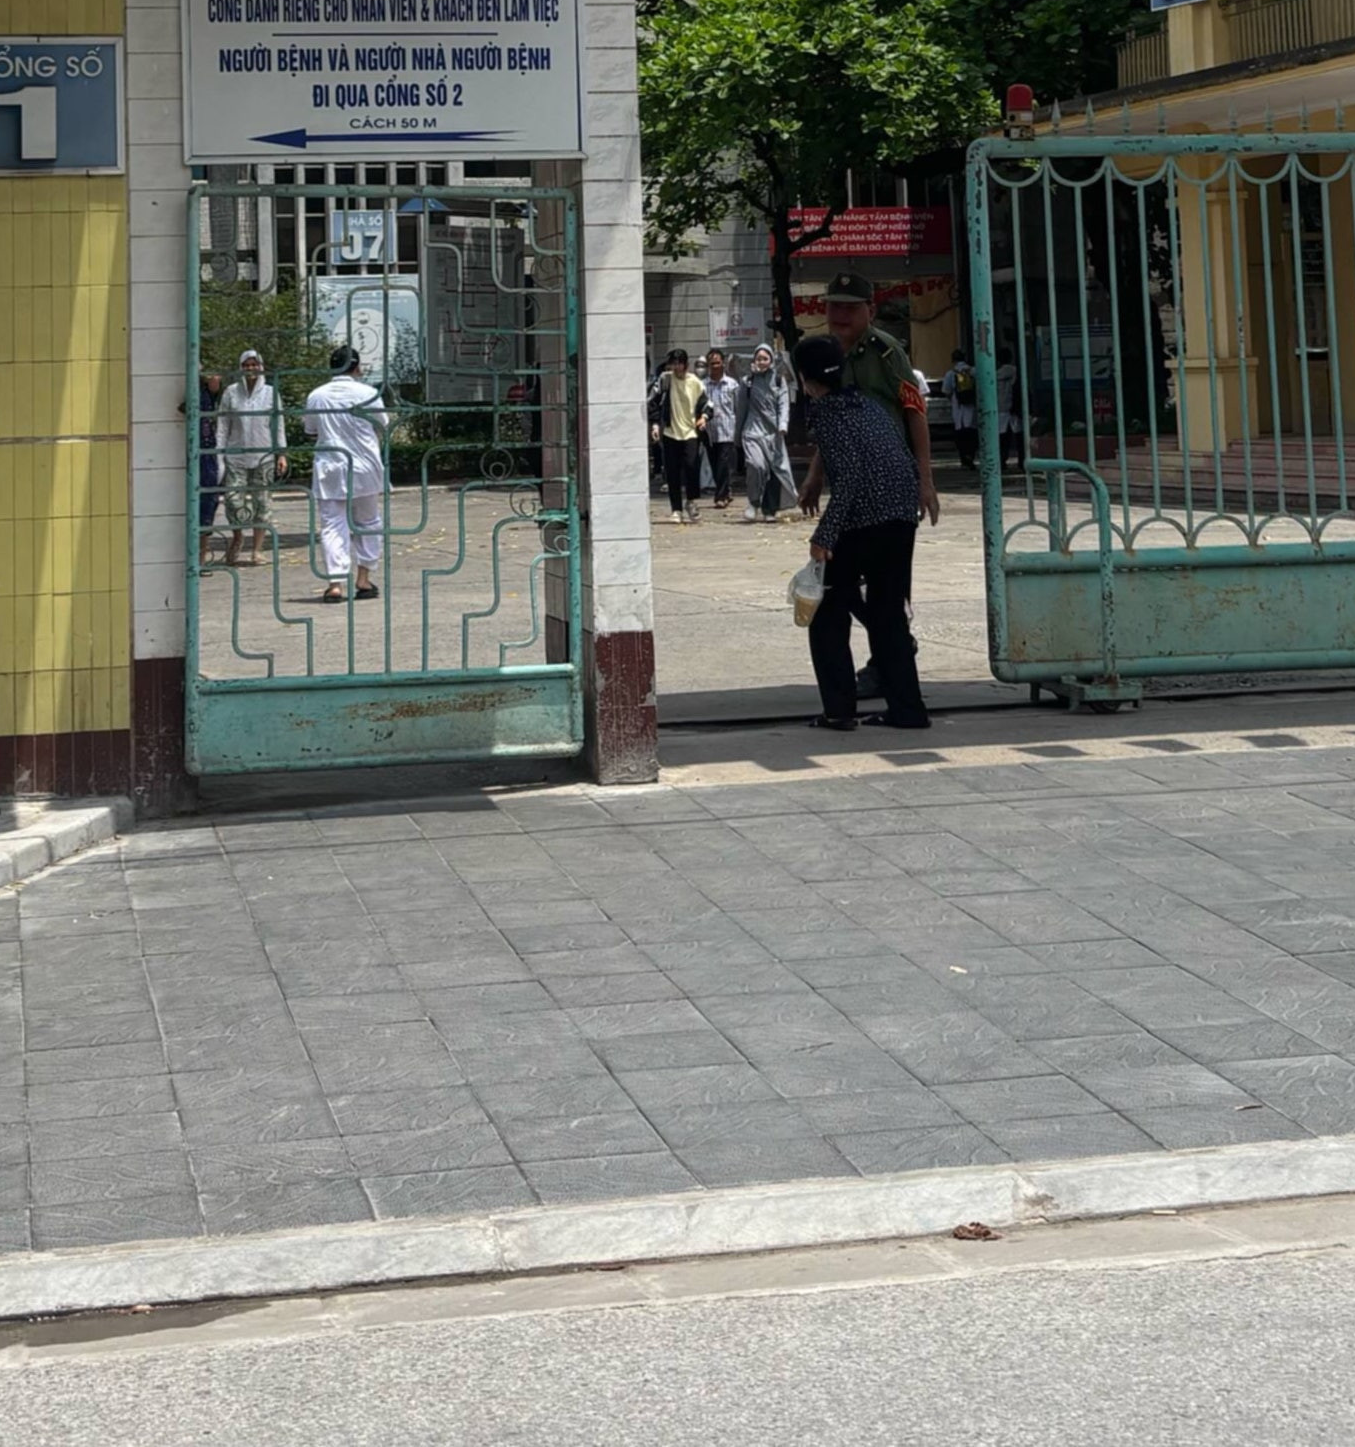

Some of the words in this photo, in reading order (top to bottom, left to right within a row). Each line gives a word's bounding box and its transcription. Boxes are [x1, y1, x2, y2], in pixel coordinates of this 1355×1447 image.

[66, 46, 104, 78] SỐ
[219, 42, 271, 72] NGƯỜI
[277, 44, 322, 77] BỆNH
[328, 43, 349, 72] VÀ
[355, 42, 406, 71] NGƯỜI
[412, 43, 446, 70] NHÀ
[452, 42, 502, 70] NGƯỜI
[508, 43, 550, 75] BỆNH
[312, 84, 329, 107] ĐI
[336, 84, 369, 110] QUA
[375, 74, 420, 106] CỔNG
[426, 75, 448, 106] SỐ
[453, 84, 463, 106] 2
[349, 115, 396, 129] CÁCH
[401, 118, 419, 129] 50
[422, 118, 437, 128] M
